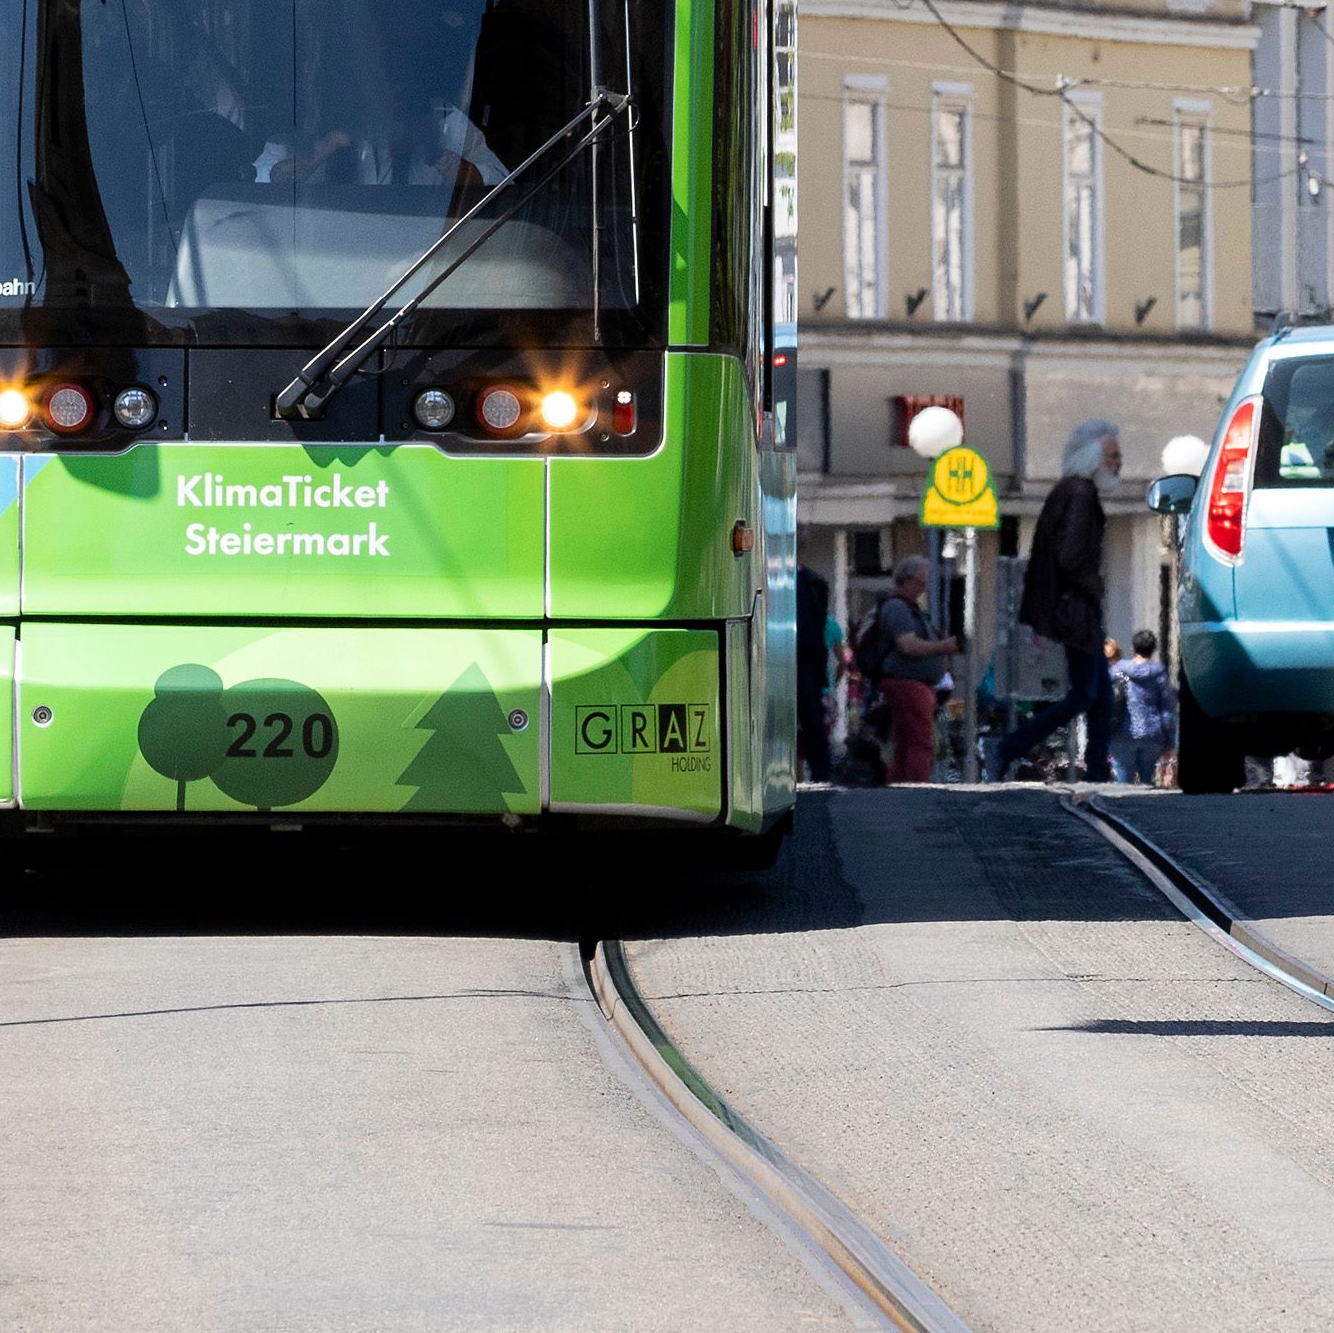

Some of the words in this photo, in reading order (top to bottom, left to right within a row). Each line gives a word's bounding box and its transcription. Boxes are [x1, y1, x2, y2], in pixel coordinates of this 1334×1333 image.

[177, 471, 390, 508] KlimaTicket
[184, 522, 391, 556] Steiermark
[225, 711, 334, 759] 220
[581, 710, 707, 750] GRAZ
[671, 756, 711, 772] HOLDING
